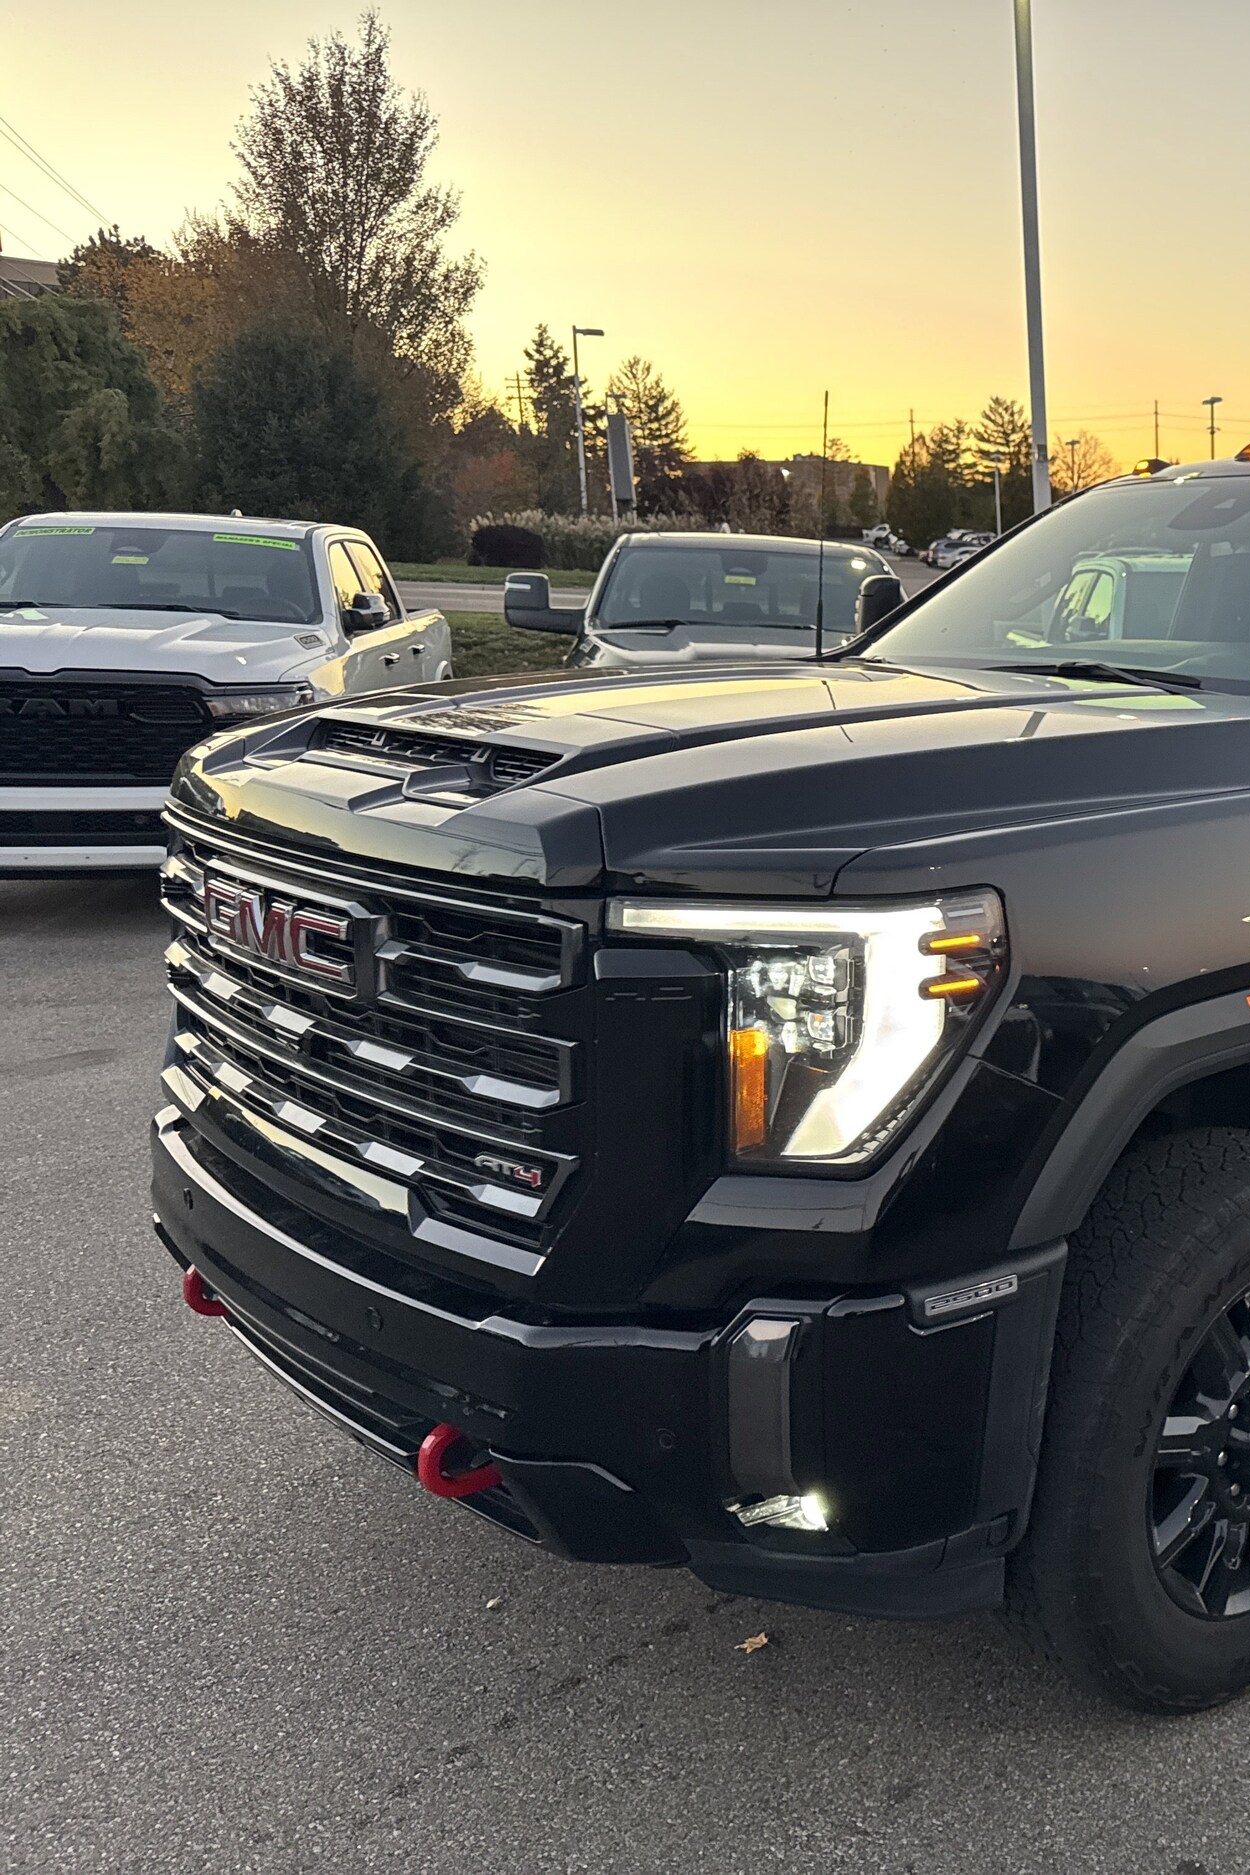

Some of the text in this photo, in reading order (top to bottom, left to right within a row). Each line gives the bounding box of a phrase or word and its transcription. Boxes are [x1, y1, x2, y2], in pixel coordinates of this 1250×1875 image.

[17, 527, 93, 537] DEMONSTRATOR
[262, 539, 293, 548] SPECIAL
[0, 698, 118, 716] AM
[204, 878, 354, 983] GMC
[474, 1154, 542, 1188] AT4
[931, 1281, 1013, 1310] 2500
